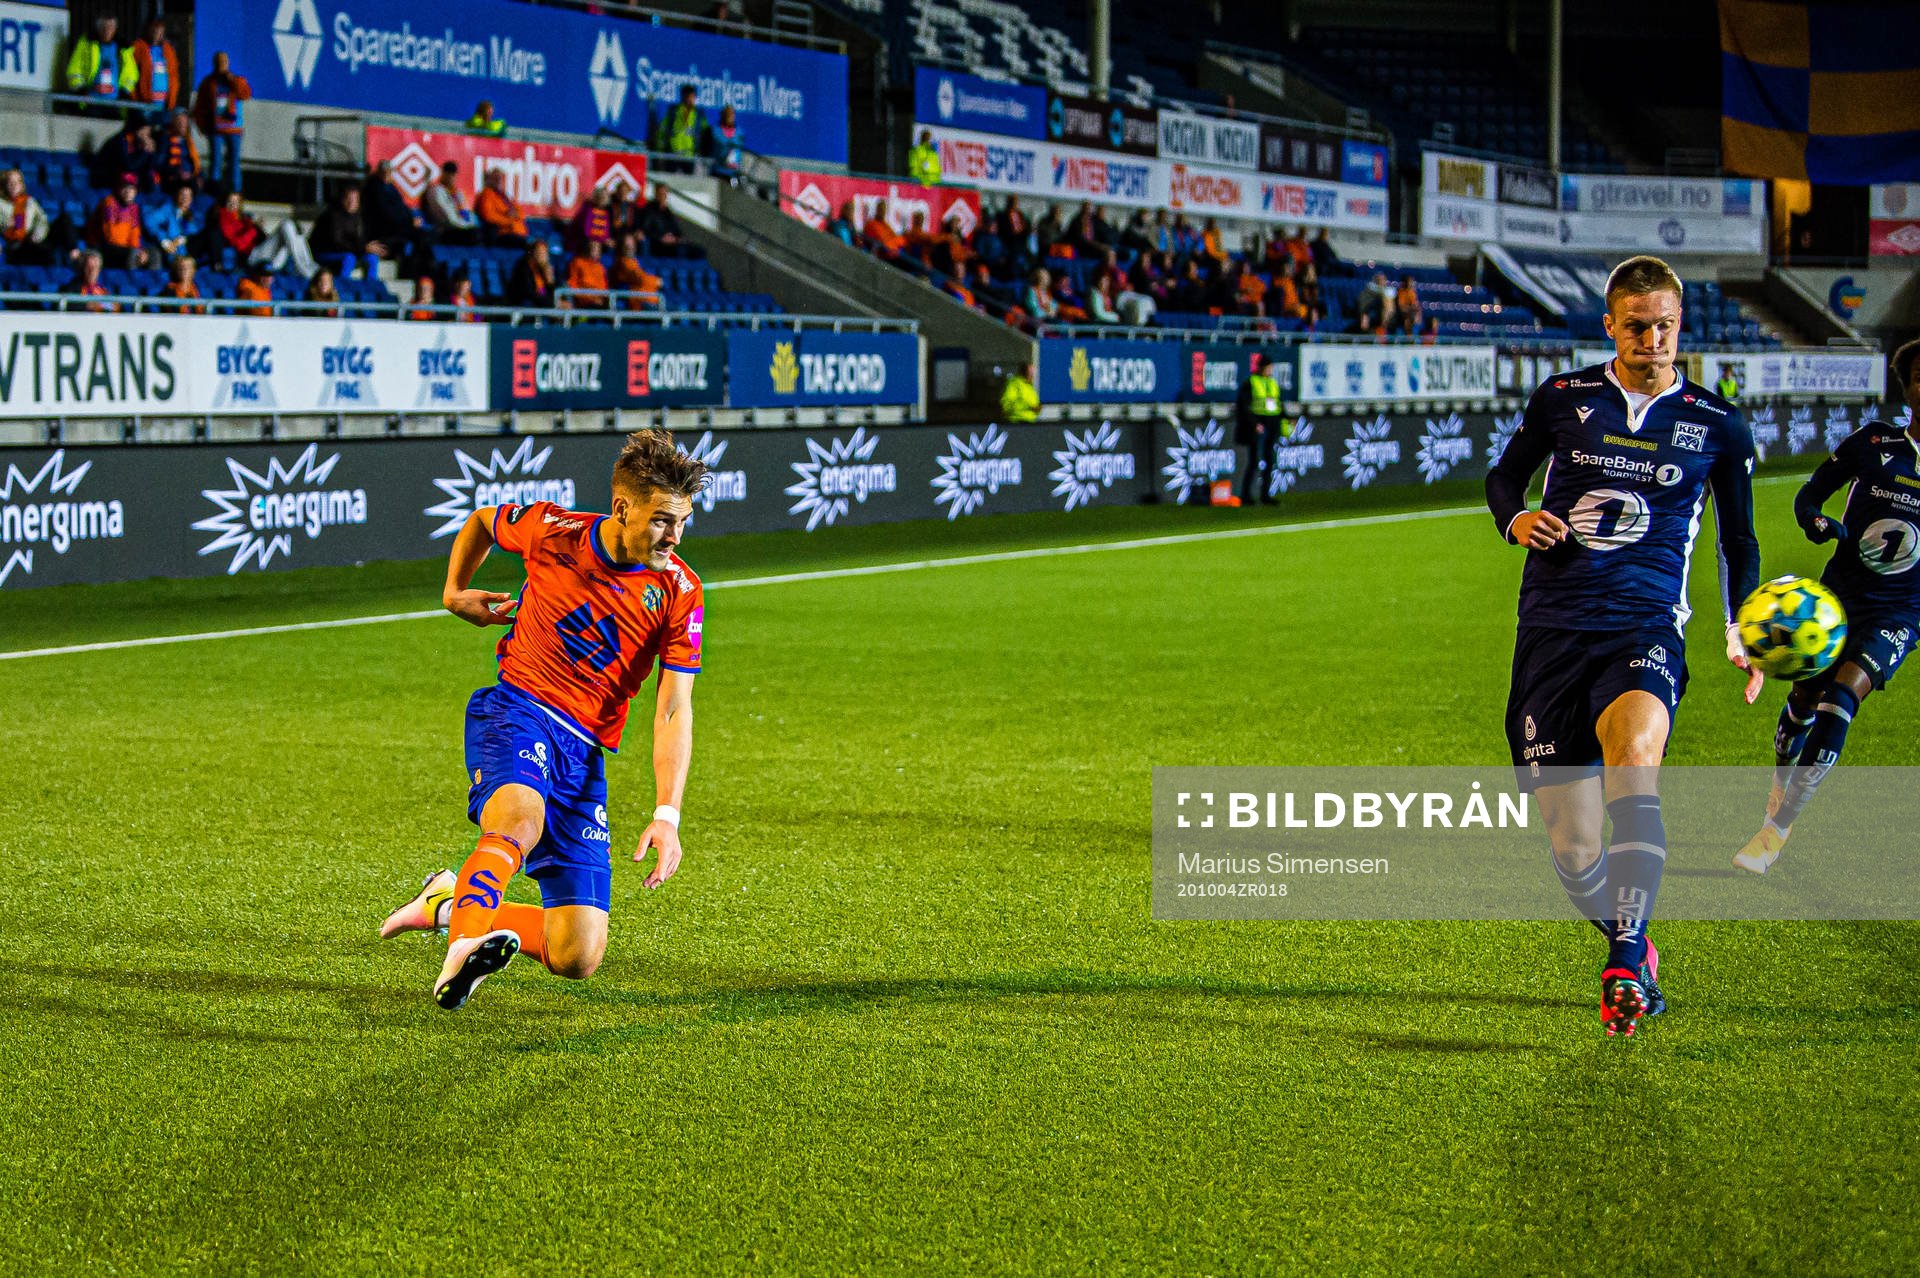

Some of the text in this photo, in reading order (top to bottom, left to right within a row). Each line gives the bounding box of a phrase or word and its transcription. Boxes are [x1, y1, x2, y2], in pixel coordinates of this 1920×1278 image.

[334, 12, 546, 85] Sparebanken Møre
[1066, 156, 1149, 198] INTERSPORT
[1590, 180, 1712, 210] gtravel.no
[217, 345, 272, 375] BYGG
[322, 346, 374, 376] BYGG
[419, 347, 467, 377] BYGG
[800, 353, 886, 393] TAFJORD
[1091, 356, 1156, 393] TAFJORD
[232, 381, 260, 400] FAG
[959, 457, 1022, 495] energima
[1075, 453, 1135, 488] energima
[1571, 450, 1656, 475] SpareBank
[1602, 468, 1653, 482] NORDVEST
[820, 463, 896, 503] energima
[0, 500, 124, 554] nergima
[249, 489, 367, 538] energima
[1629, 658, 1676, 687] olivita
[518, 749, 546, 770] Color
